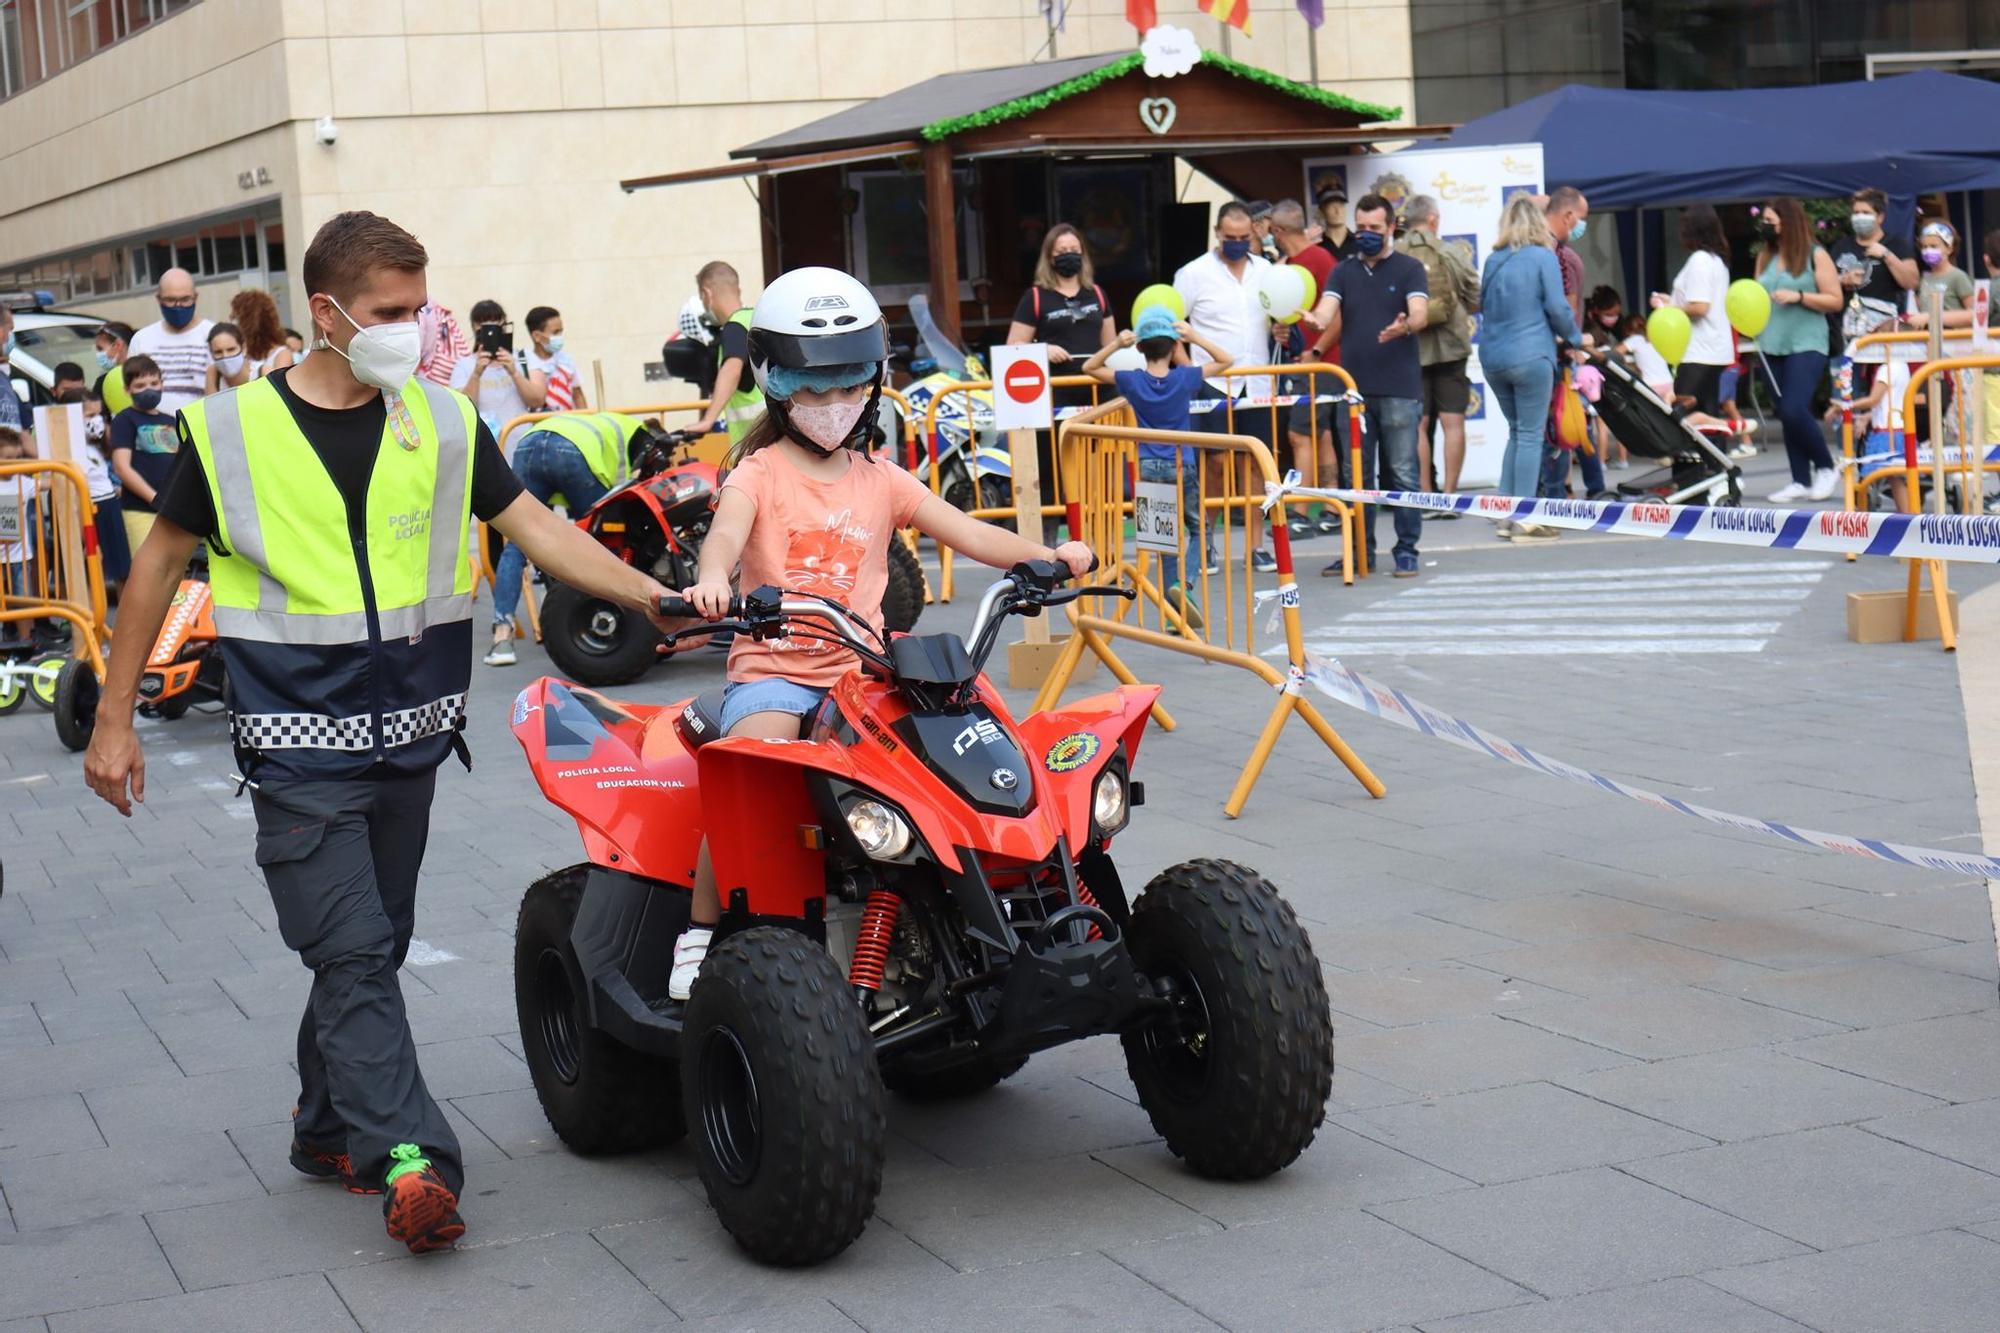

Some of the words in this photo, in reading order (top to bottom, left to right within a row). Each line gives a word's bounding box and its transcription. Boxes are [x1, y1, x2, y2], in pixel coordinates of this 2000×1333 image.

[1154, 515, 1174, 537] Onda
[1631, 504, 1643, 522] NO
[1710, 510, 1746, 532] POLICIA
[1747, 511, 1777, 535] LOCAL
[1820, 512, 1834, 537] NO
[1836, 512, 1870, 538] PASAR
[1920, 514, 1965, 546] POLICIA
[557, 767, 600, 778] POLICIA
[602, 765, 636, 774] LOCAL
[596, 779, 659, 789] EDUCACION
[660, 780, 686, 788] VIAL
